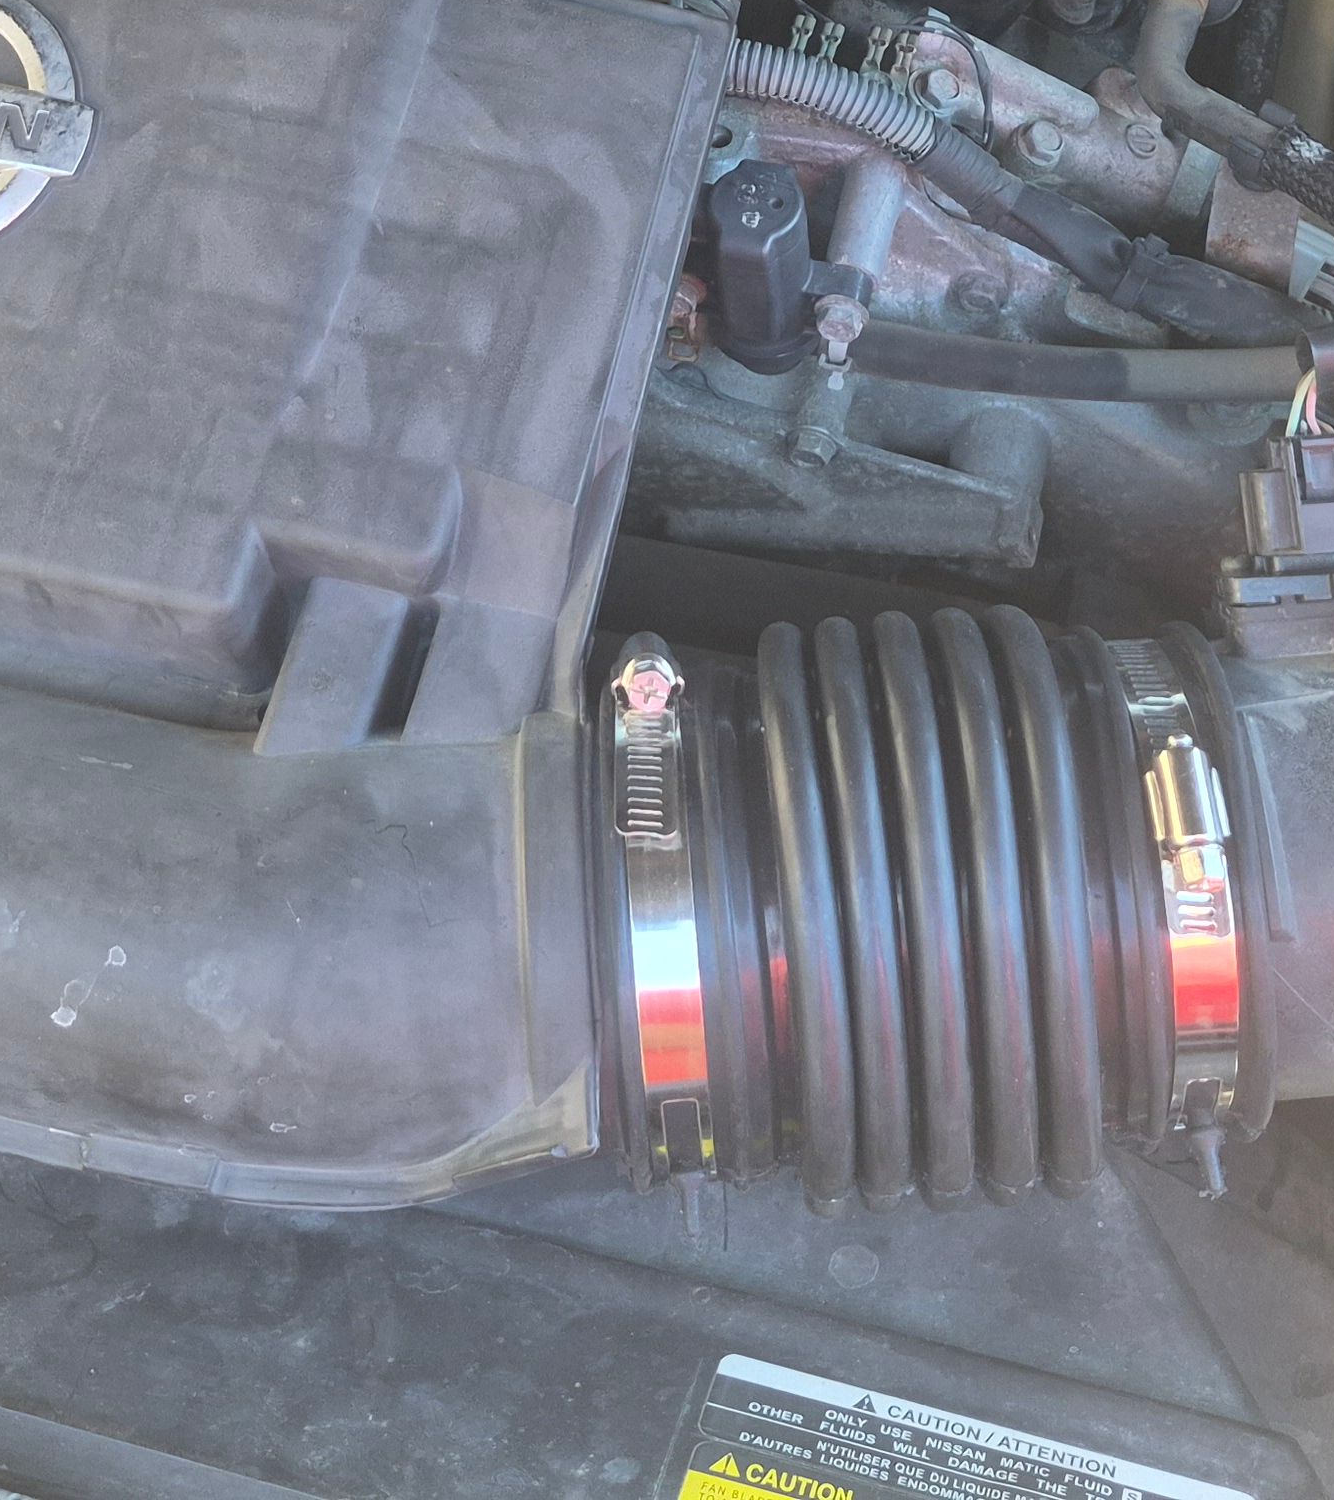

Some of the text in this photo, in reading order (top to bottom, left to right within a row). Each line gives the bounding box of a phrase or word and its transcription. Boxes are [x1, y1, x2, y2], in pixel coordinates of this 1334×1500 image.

[739, 1431, 814, 1460] D'AUTRES
[819, 1455, 890, 1482] LIQUIDES
[748, 1401, 804, 1425] OTHER
[819, 1421, 876, 1445] FLUIDS
[893, 1441, 931, 1460] WILL
[948, 1457, 1019, 1483] DAMAGE
[1036, 1478, 1067, 1496] THE
[817, 1440, 1011, 1500] N'UTILISER QUE DU LIQUIDE
[824, 1409, 869, 1428] ONLY
[880, 1424, 912, 1441] USE
[925, 1437, 987, 1461] NISSAN
[1000, 1457, 1051, 1478] MATIC
[1064, 1473, 1113, 1497] FLUID
[887, 1404, 982, 1441] CAUTION
[998, 1435, 1117, 1478] ATTENTION
[701, 1481, 727, 1497] FAN
[746, 1463, 854, 1500] CAUTION
